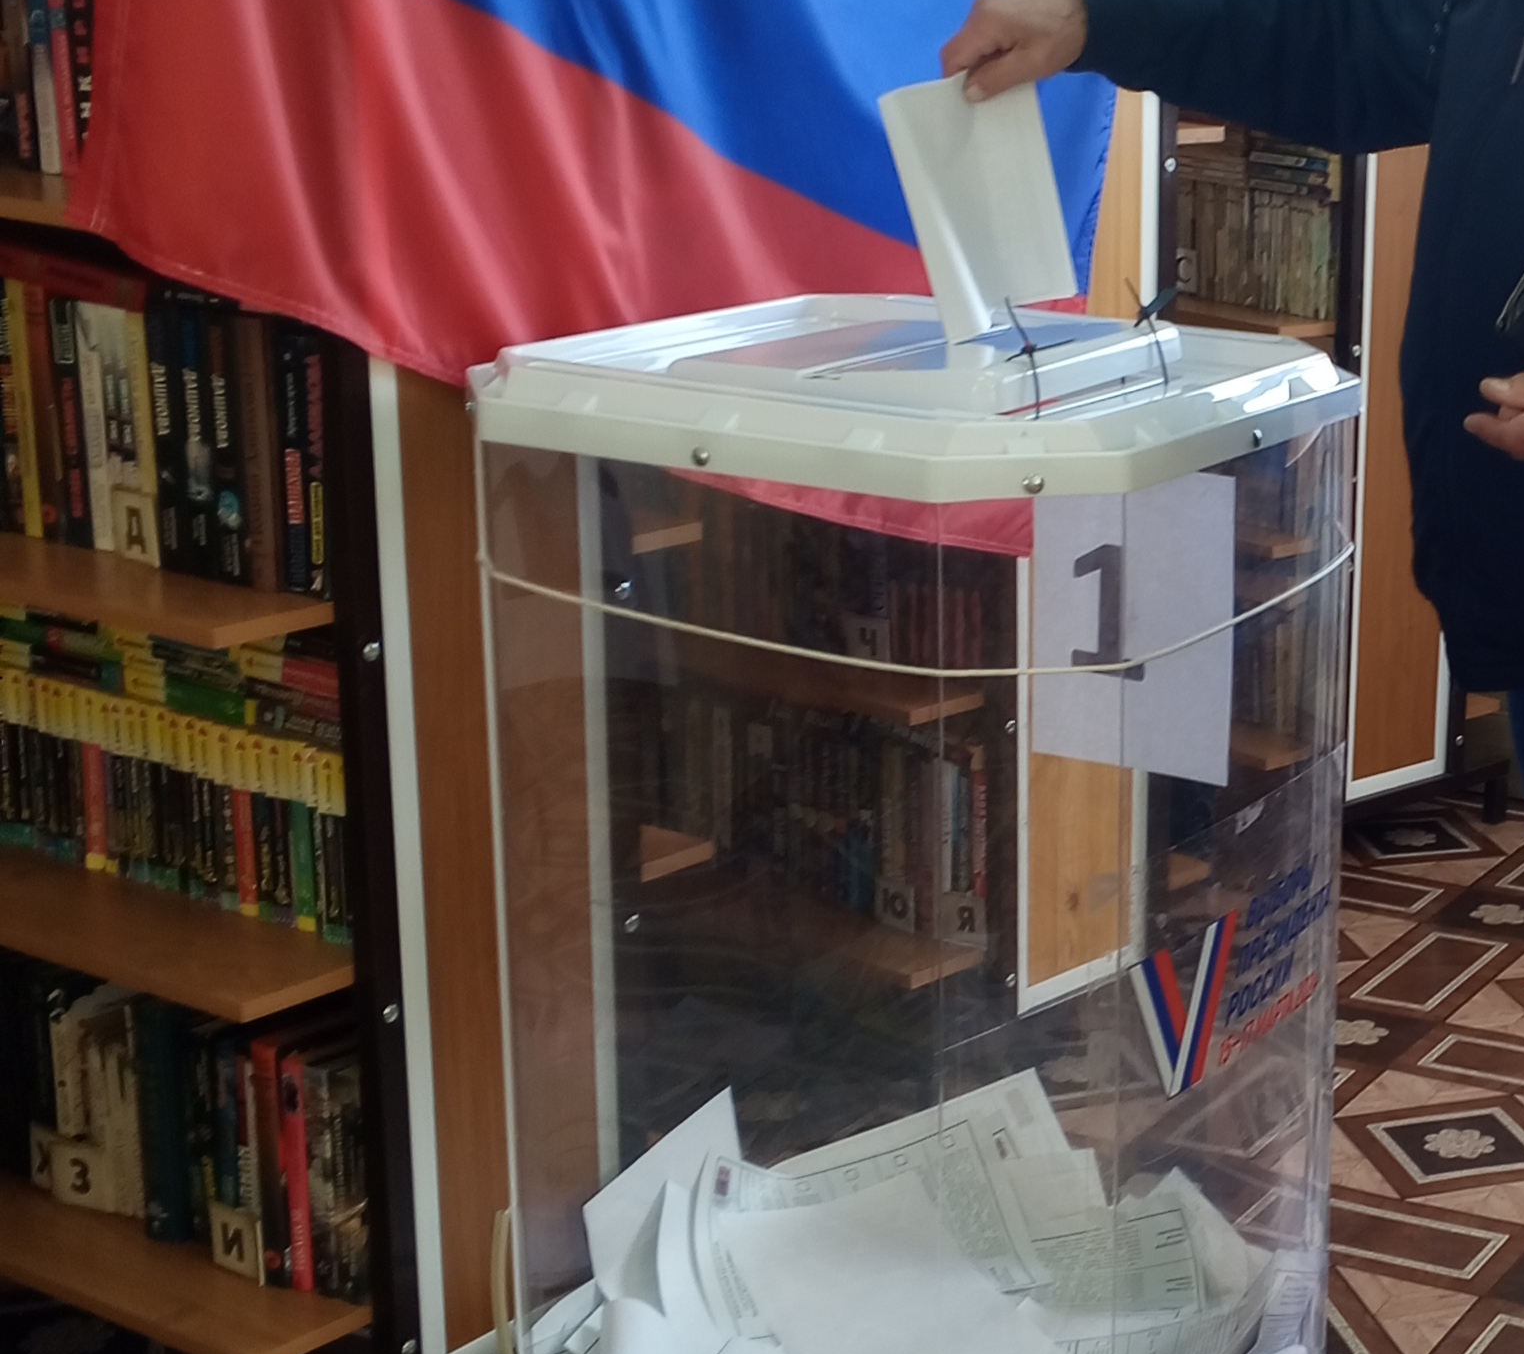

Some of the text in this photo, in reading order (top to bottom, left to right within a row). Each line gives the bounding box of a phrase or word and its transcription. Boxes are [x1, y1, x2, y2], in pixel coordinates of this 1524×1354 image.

[126, 506, 147, 554] А
[1071, 543, 1145, 682] 1
[956, 905, 976, 935] Я
[1224, 950, 1294, 1027] РОССИИ
